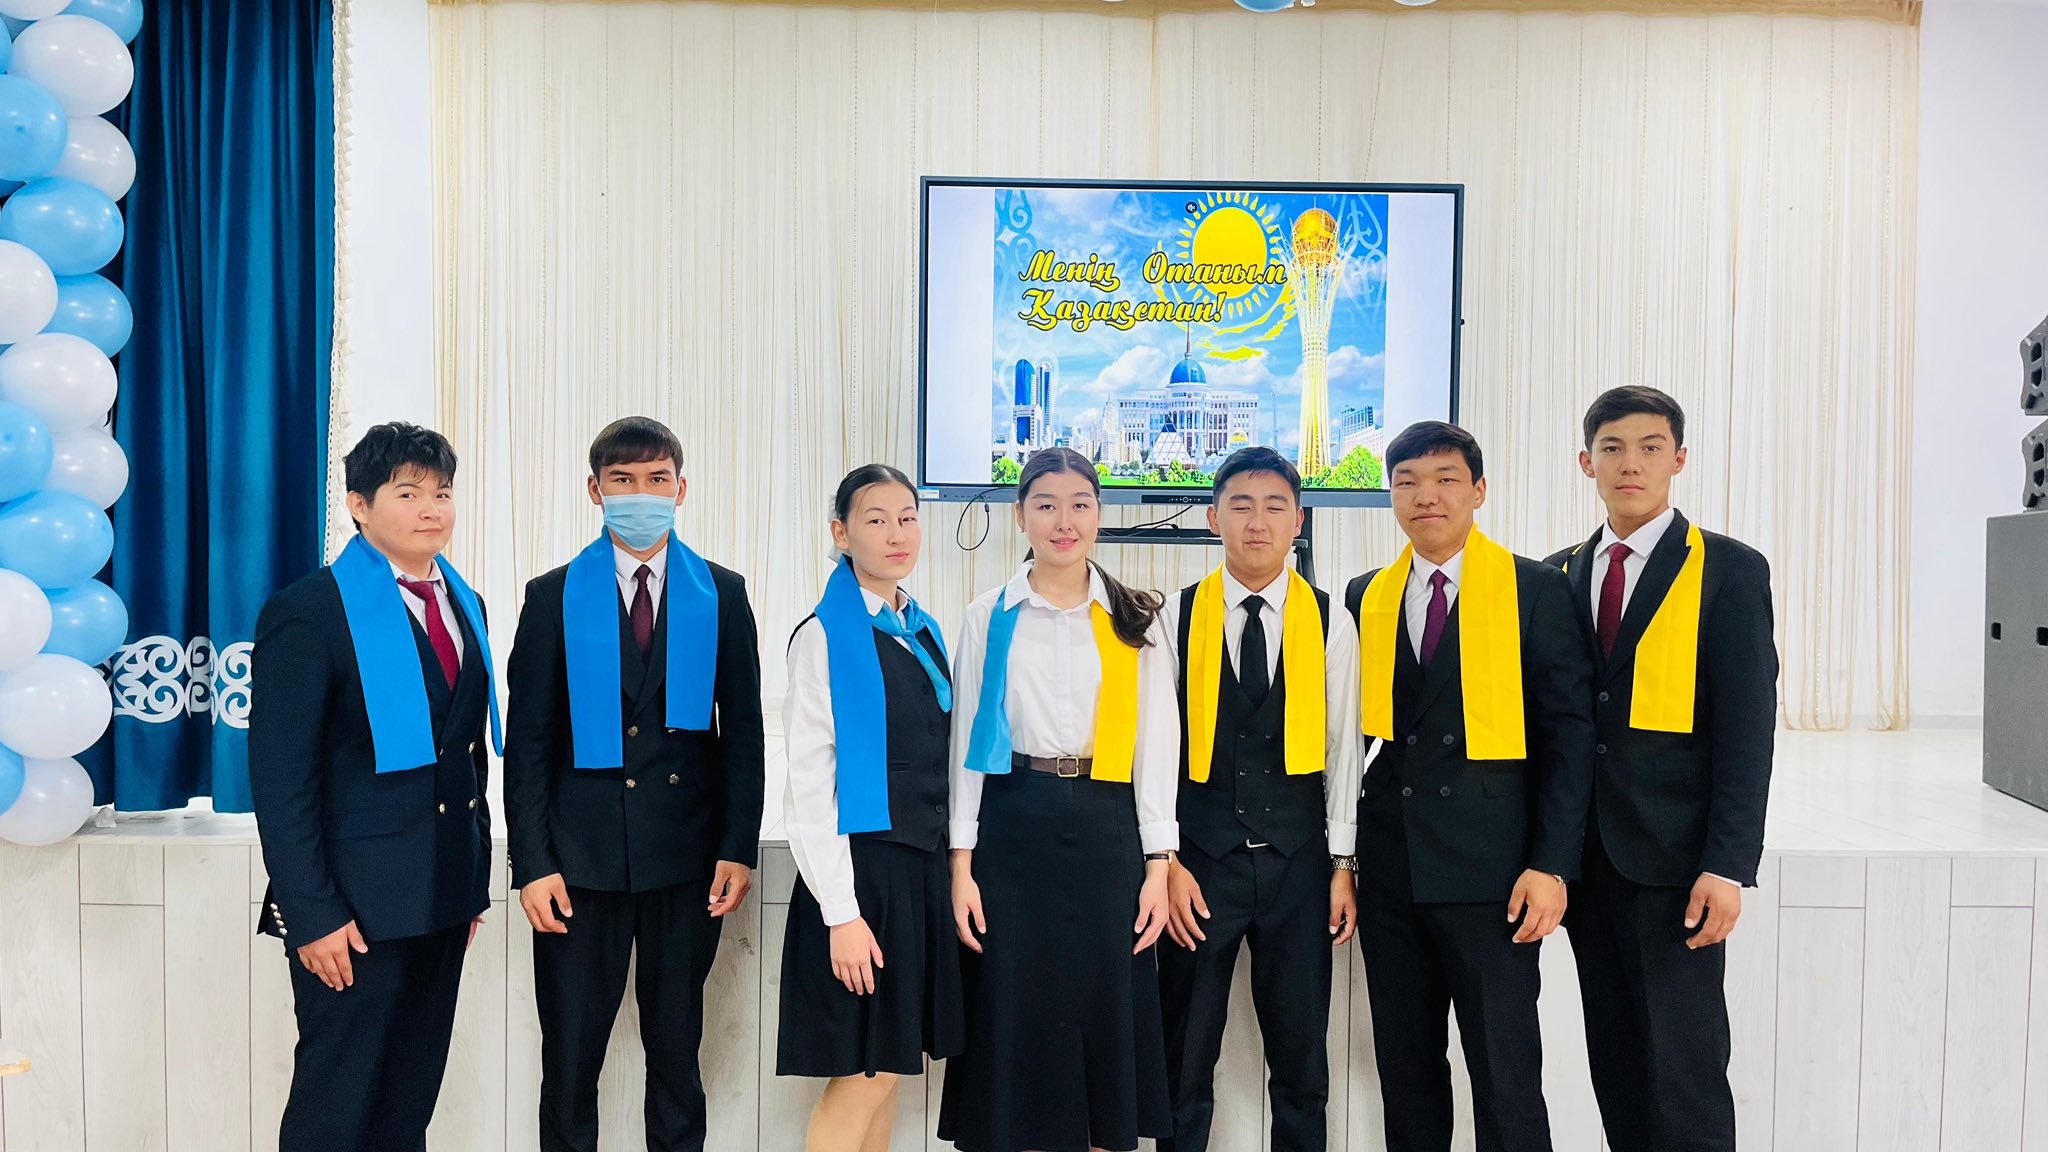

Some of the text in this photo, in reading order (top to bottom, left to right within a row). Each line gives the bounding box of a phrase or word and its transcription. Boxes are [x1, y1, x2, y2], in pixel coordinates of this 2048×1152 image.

[1019, 250, 1287, 292] Менің Отаным
[1018, 288, 1227, 332] Қазақстан!
